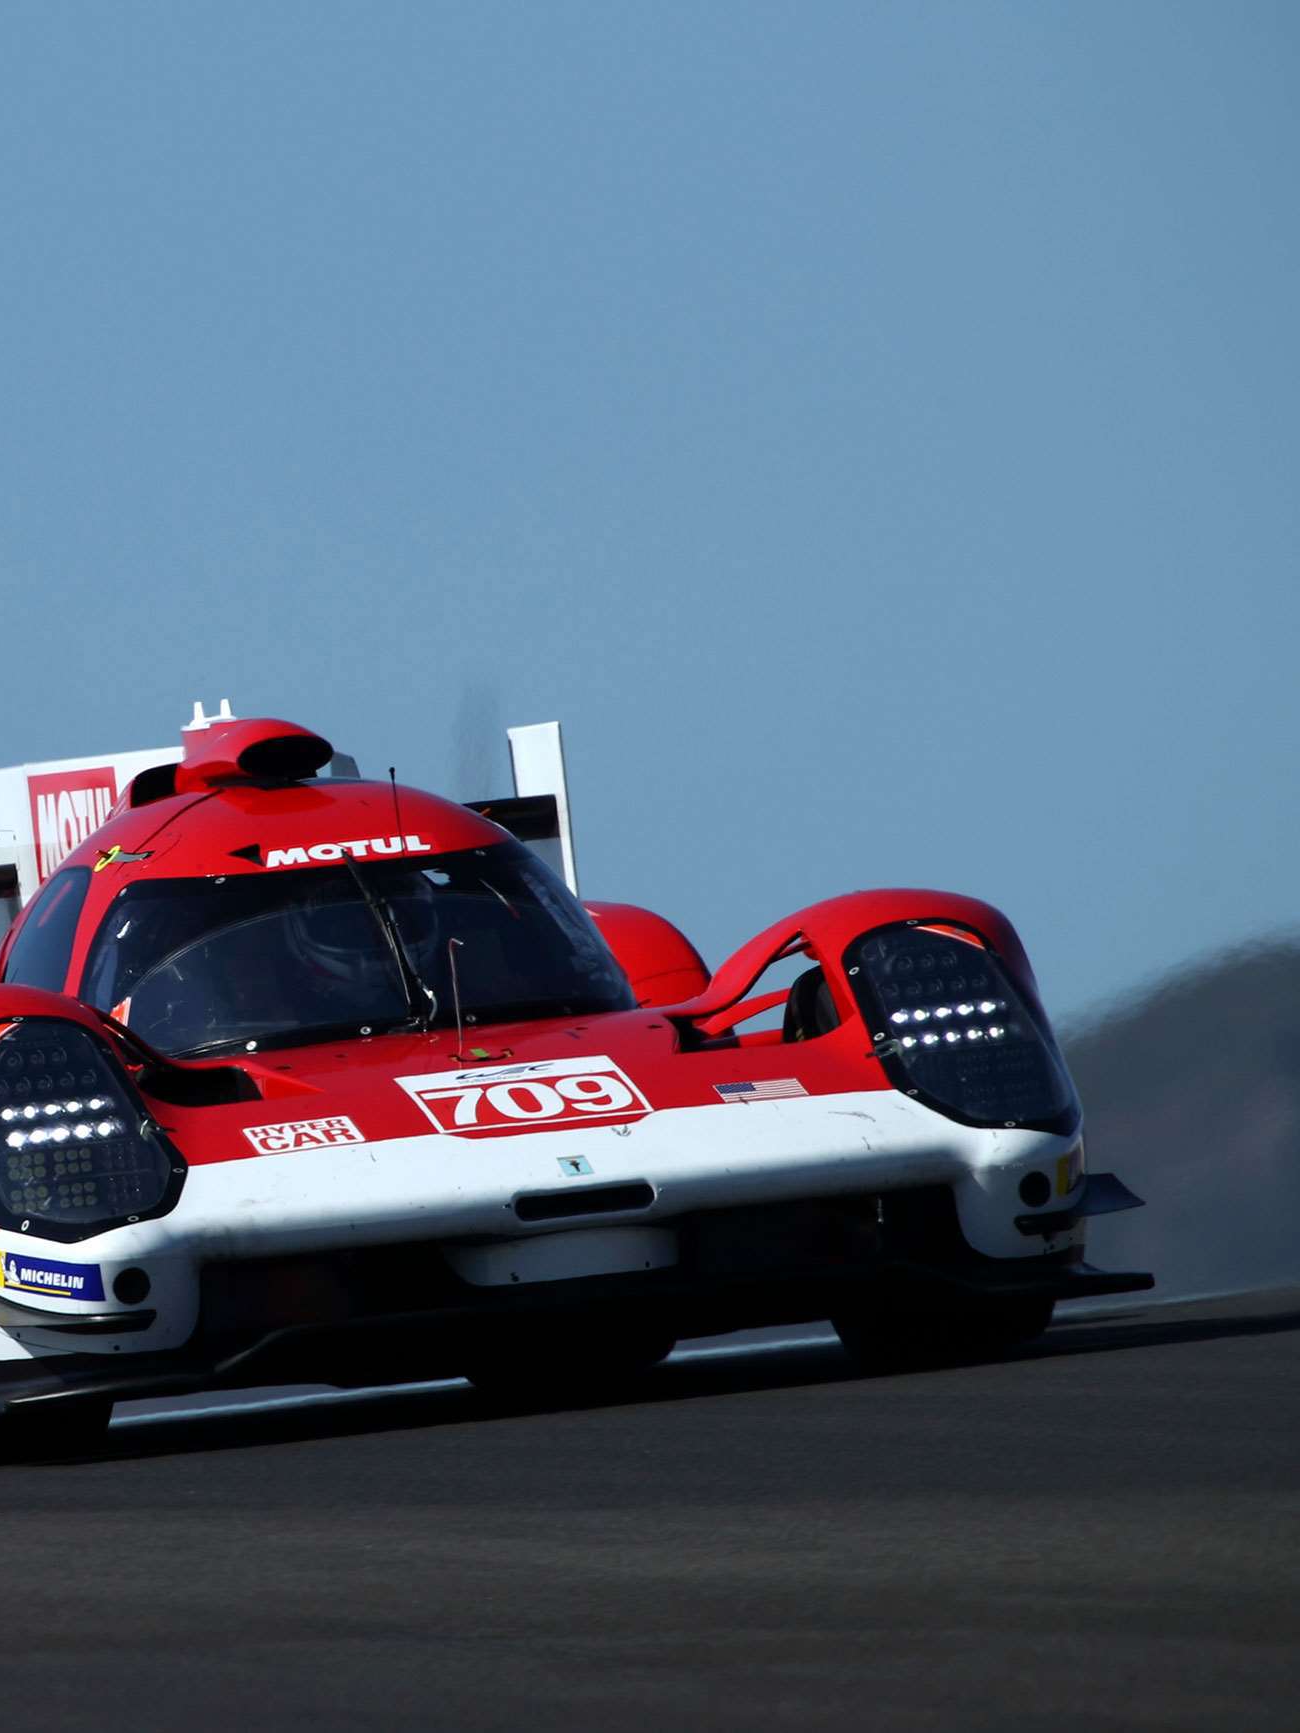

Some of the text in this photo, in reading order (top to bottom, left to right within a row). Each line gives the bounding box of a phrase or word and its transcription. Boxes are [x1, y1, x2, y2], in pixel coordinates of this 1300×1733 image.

[266, 835, 431, 868] MOTUL
[422, 1076, 632, 1126] 709
[250, 1118, 346, 1138] HYPER
[258, 1128, 358, 1151] CAR
[20, 1268, 85, 1290] MICHELIN
